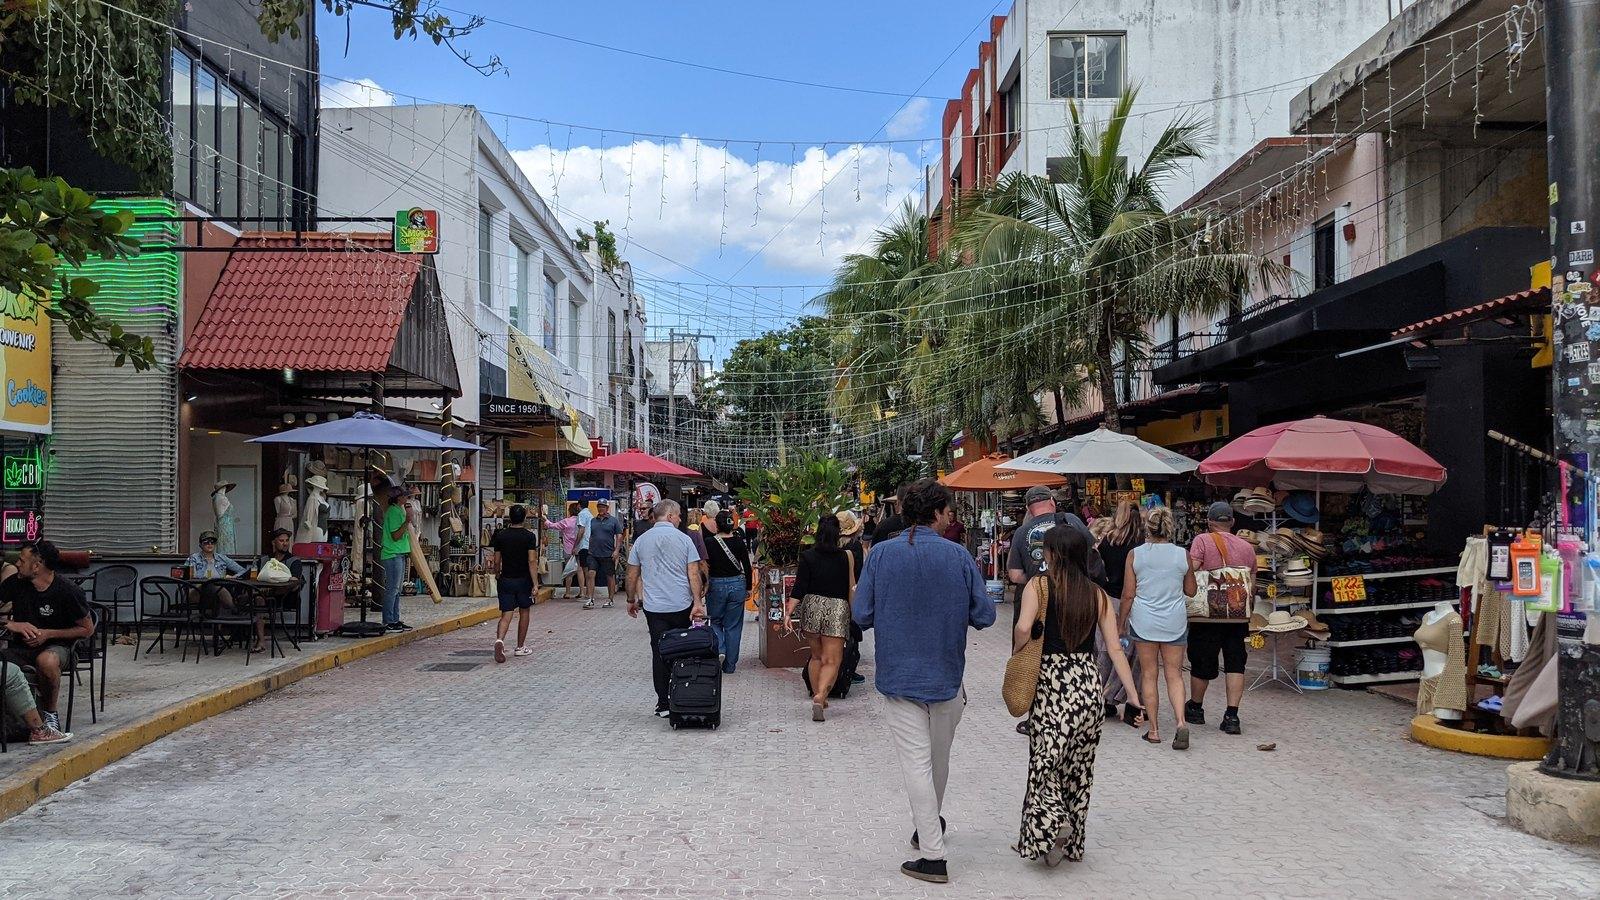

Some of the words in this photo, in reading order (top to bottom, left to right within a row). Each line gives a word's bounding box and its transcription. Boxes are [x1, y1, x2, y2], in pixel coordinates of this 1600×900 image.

[7, 379, 48, 407] Cookies
[490, 404, 516, 413] SINCE
[518, 404, 537, 413] 1950
[5, 519, 26, 533] HOOKAH
